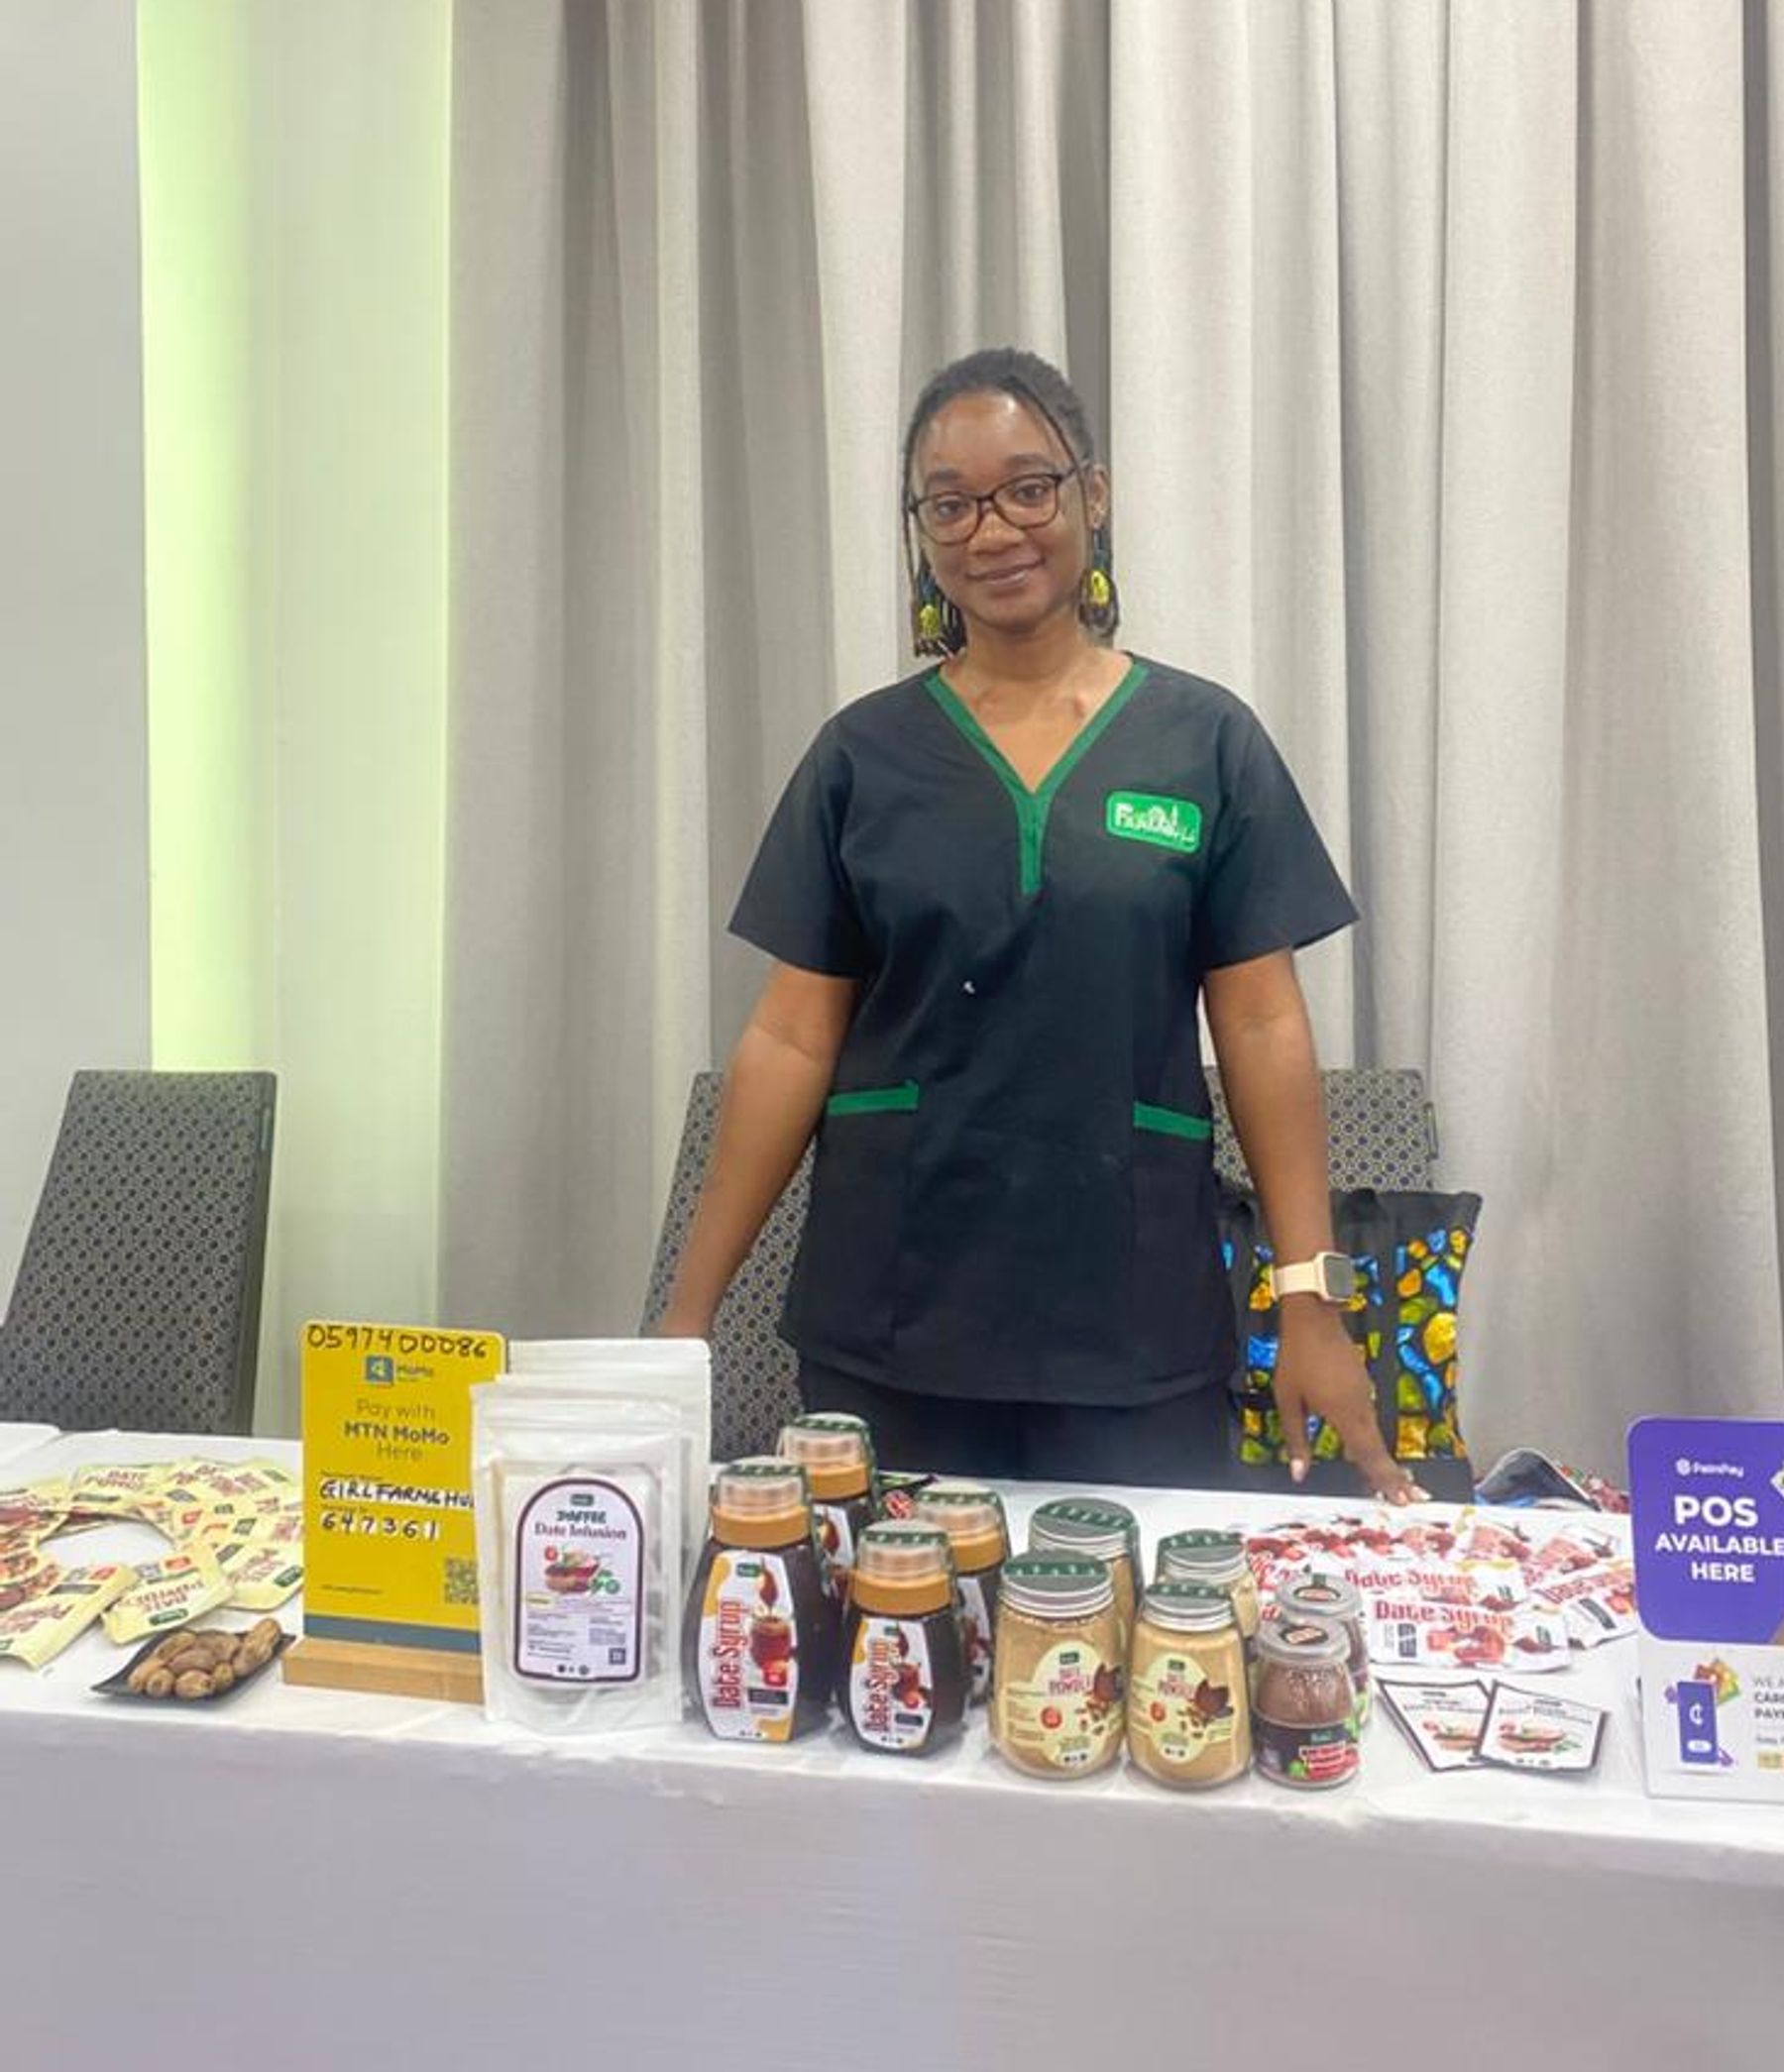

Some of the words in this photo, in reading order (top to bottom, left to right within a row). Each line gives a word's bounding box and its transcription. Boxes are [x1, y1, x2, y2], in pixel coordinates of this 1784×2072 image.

[356, 1398, 391, 1418] Pay
[396, 1404, 436, 1419] with
[345, 1422, 388, 1439] MTN
[393, 1426, 451, 1445] MoMo
[376, 1443, 423, 1461] Here
[319, 1478, 372, 1500] GIRL
[1674, 1494, 1759, 1528] POS
[534, 1521, 566, 1536] Date
[569, 1524, 626, 1540] Infusion
[1655, 1532, 1784, 1557] AVAILABLE
[1691, 1561, 1755, 1583] HERE
[712, 1599, 748, 1659] Syrup
[1376, 1600, 1435, 1622] Date
[1440, 1604, 1514, 1637] Syrup
[712, 1665, 741, 1708] Date
